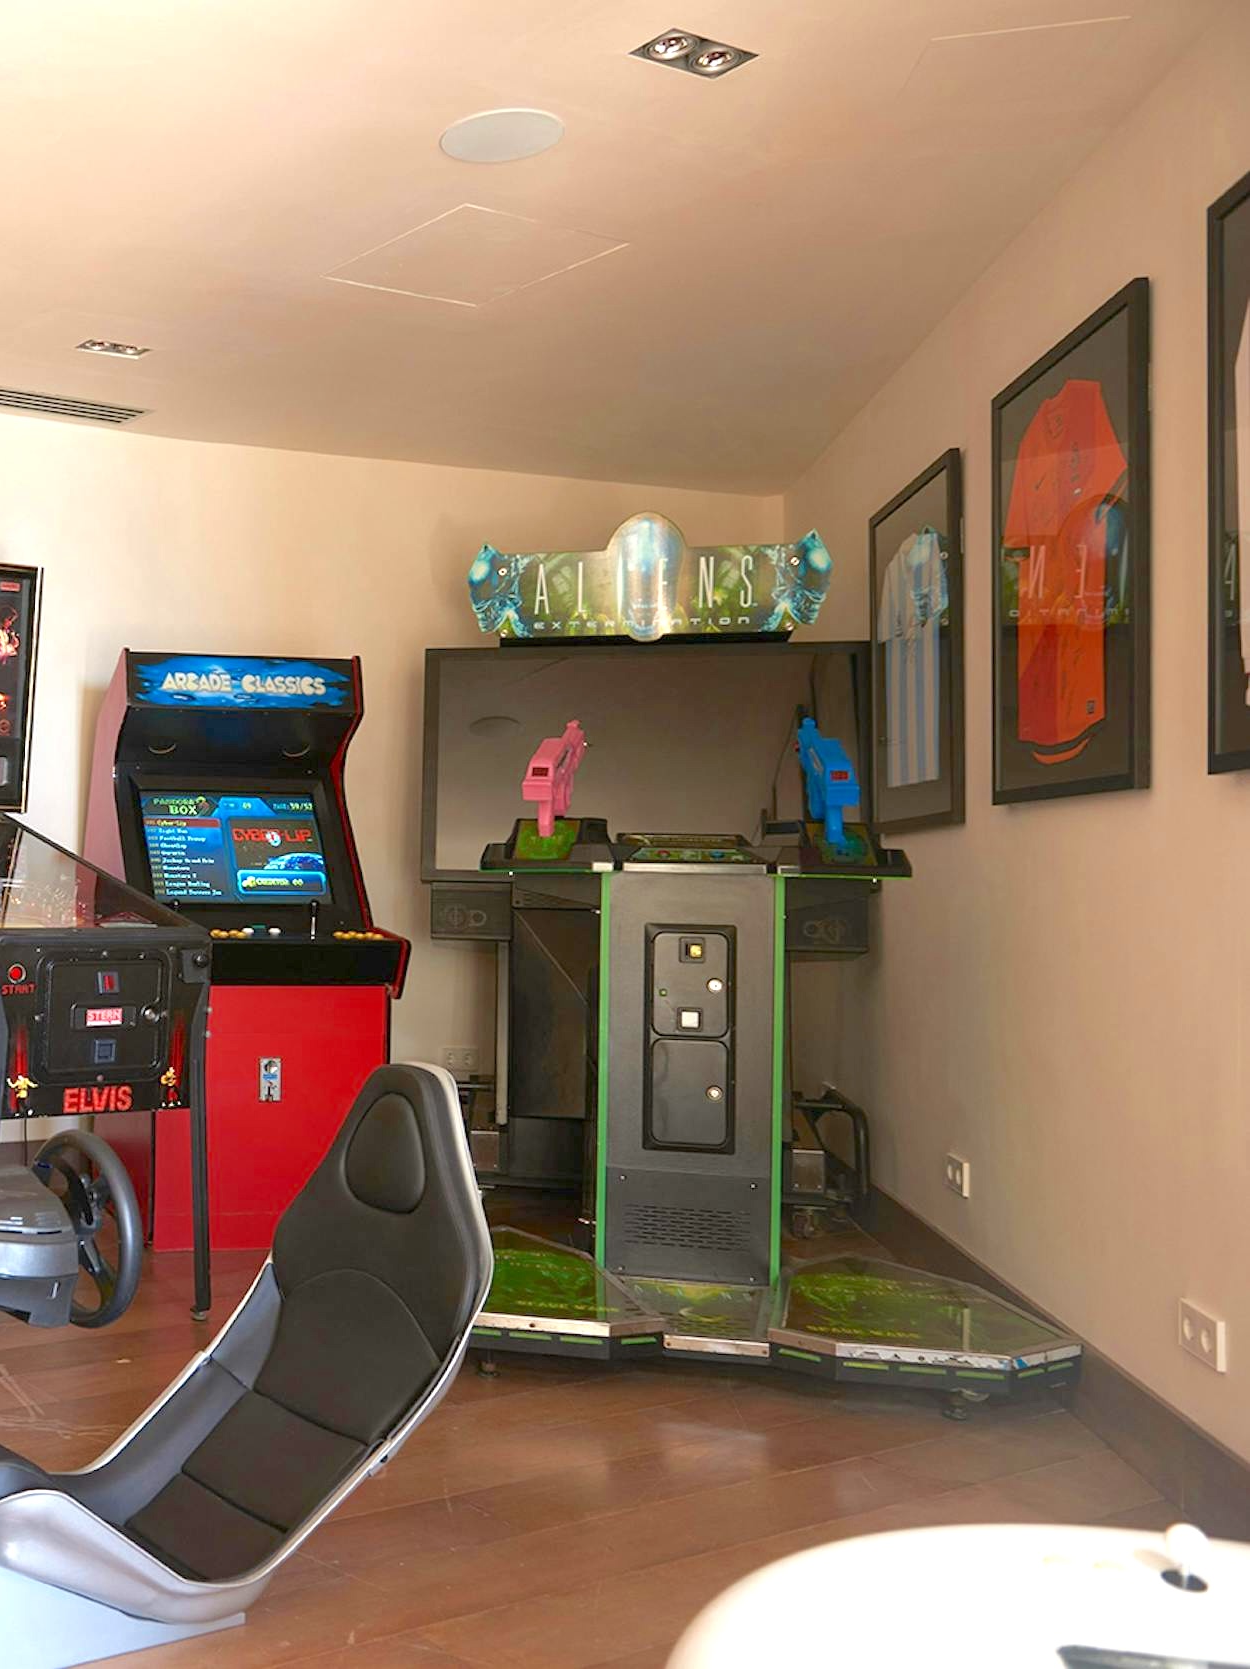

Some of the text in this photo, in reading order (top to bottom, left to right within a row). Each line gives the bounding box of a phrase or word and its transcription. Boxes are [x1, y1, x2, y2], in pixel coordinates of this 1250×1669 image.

[161, 672, 327, 696] ARCADE CLASSICS
[168, 805, 197, 815] BOX
[1, 984, 36, 997] START
[87, 1009, 122, 1022] STERN
[63, 1085, 133, 1114] ELVIS
